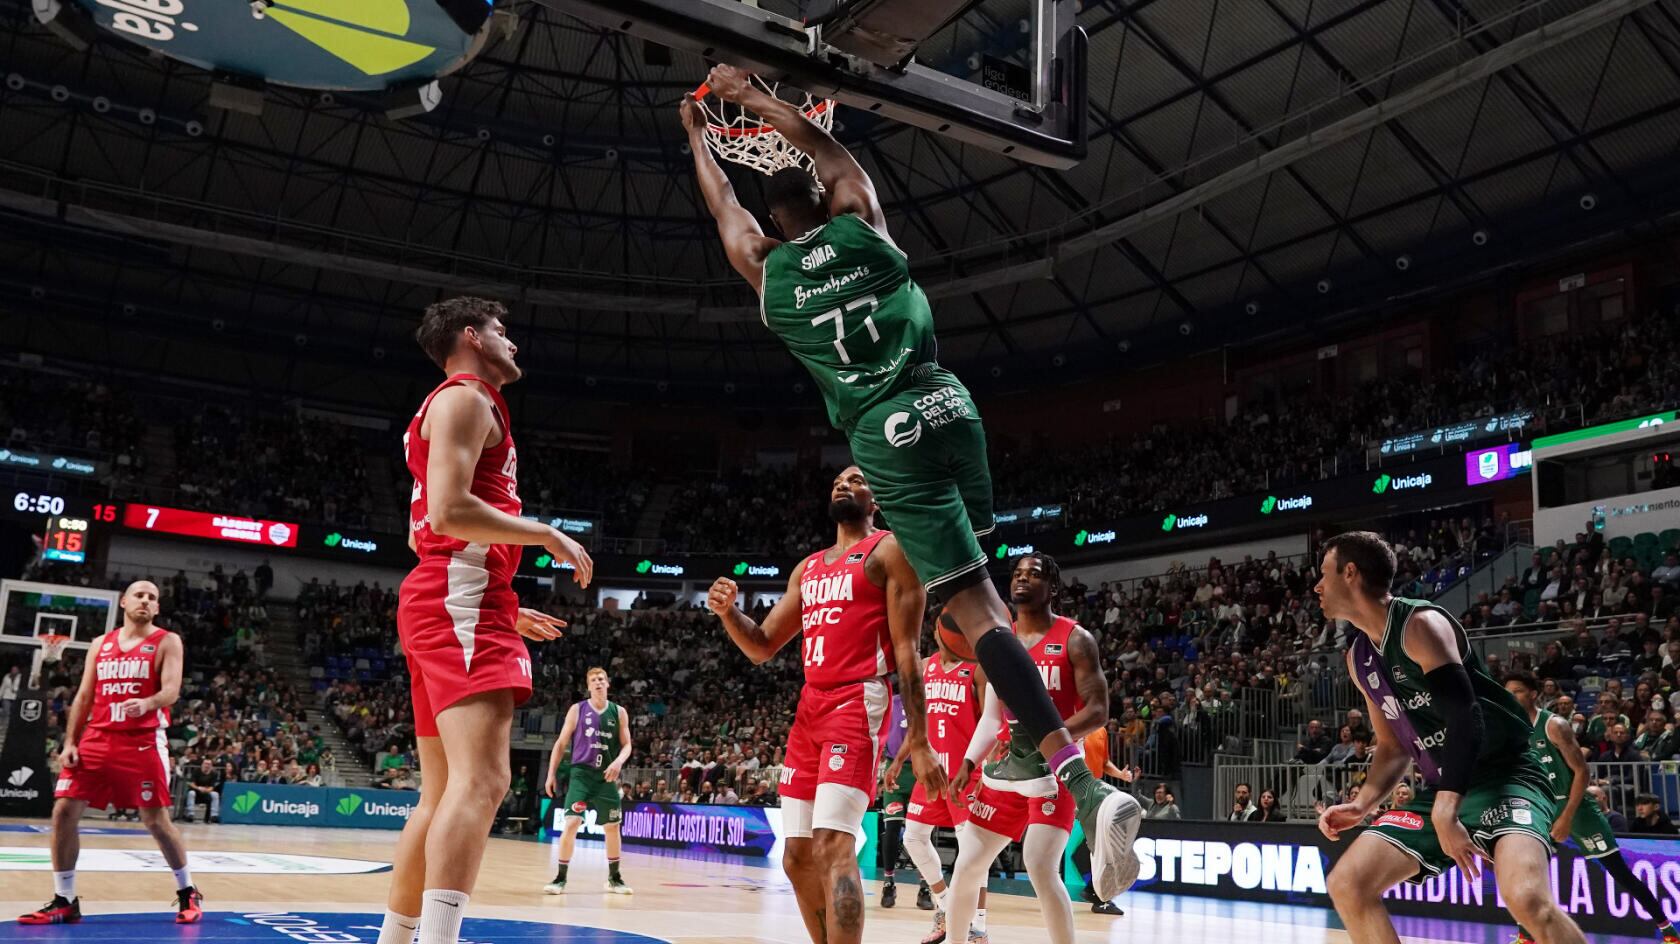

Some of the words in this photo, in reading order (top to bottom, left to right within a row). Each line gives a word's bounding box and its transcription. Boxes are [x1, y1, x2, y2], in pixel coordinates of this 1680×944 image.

[801, 244, 836, 270] SIMA
[811, 294, 880, 364] 77
[913, 386, 958, 411] COSTA
[922, 407, 947, 420] DEL
[944, 397, 966, 410] SOL
[1392, 473, 1432, 491] Unicaja
[14, 492, 64, 515] 6:50
[92, 503, 117, 522] 15
[1276, 497, 1313, 513] Unicaja
[145, 507, 160, 529] 7
[1177, 514, 1208, 528] Unicaja
[53, 531, 82, 552] 15
[342, 538, 376, 552] Unicaja
[1088, 531, 1116, 543] Unicaja
[1008, 545, 1033, 557] Unicaja
[652, 565, 684, 576] Unicaja
[748, 566, 779, 577] Unicaja
[804, 635, 825, 667] 24
[96, 660, 149, 681] GIRONA
[925, 682, 966, 703] GIRONA
[937, 719, 945, 738] 5
[595, 754, 603, 768] 9
[262, 799, 319, 818] Unicaja
[622, 806, 653, 838] JARDÍN
[653, 813, 665, 840] DE
[665, 814, 676, 840] LA
[678, 814, 706, 843] COSTA
[708, 816, 725, 844] DEL
[727, 817, 746, 846] SOL
